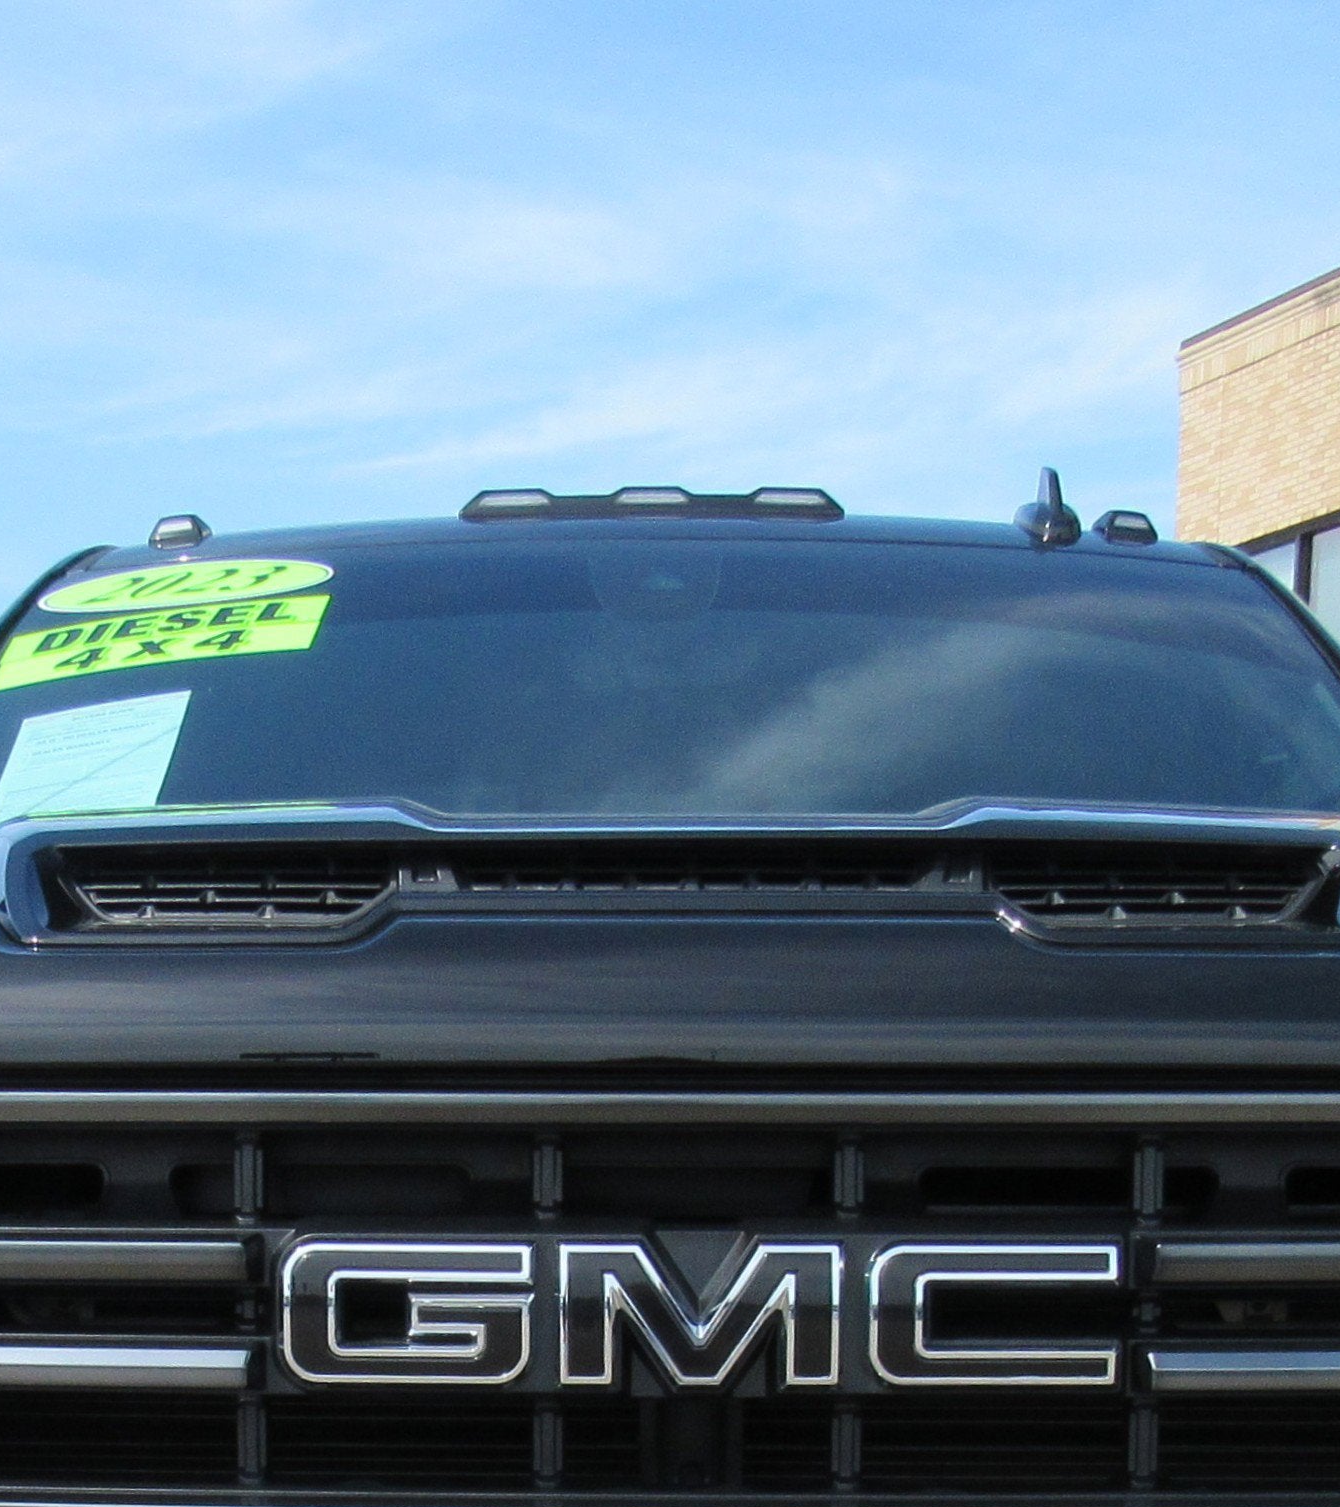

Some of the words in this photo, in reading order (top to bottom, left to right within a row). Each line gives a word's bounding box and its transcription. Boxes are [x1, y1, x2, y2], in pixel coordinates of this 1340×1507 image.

[77, 566, 288, 606] 2023
[34, 602, 294, 654] DIESEL
[282, 1242, 1119, 1386] GMC
